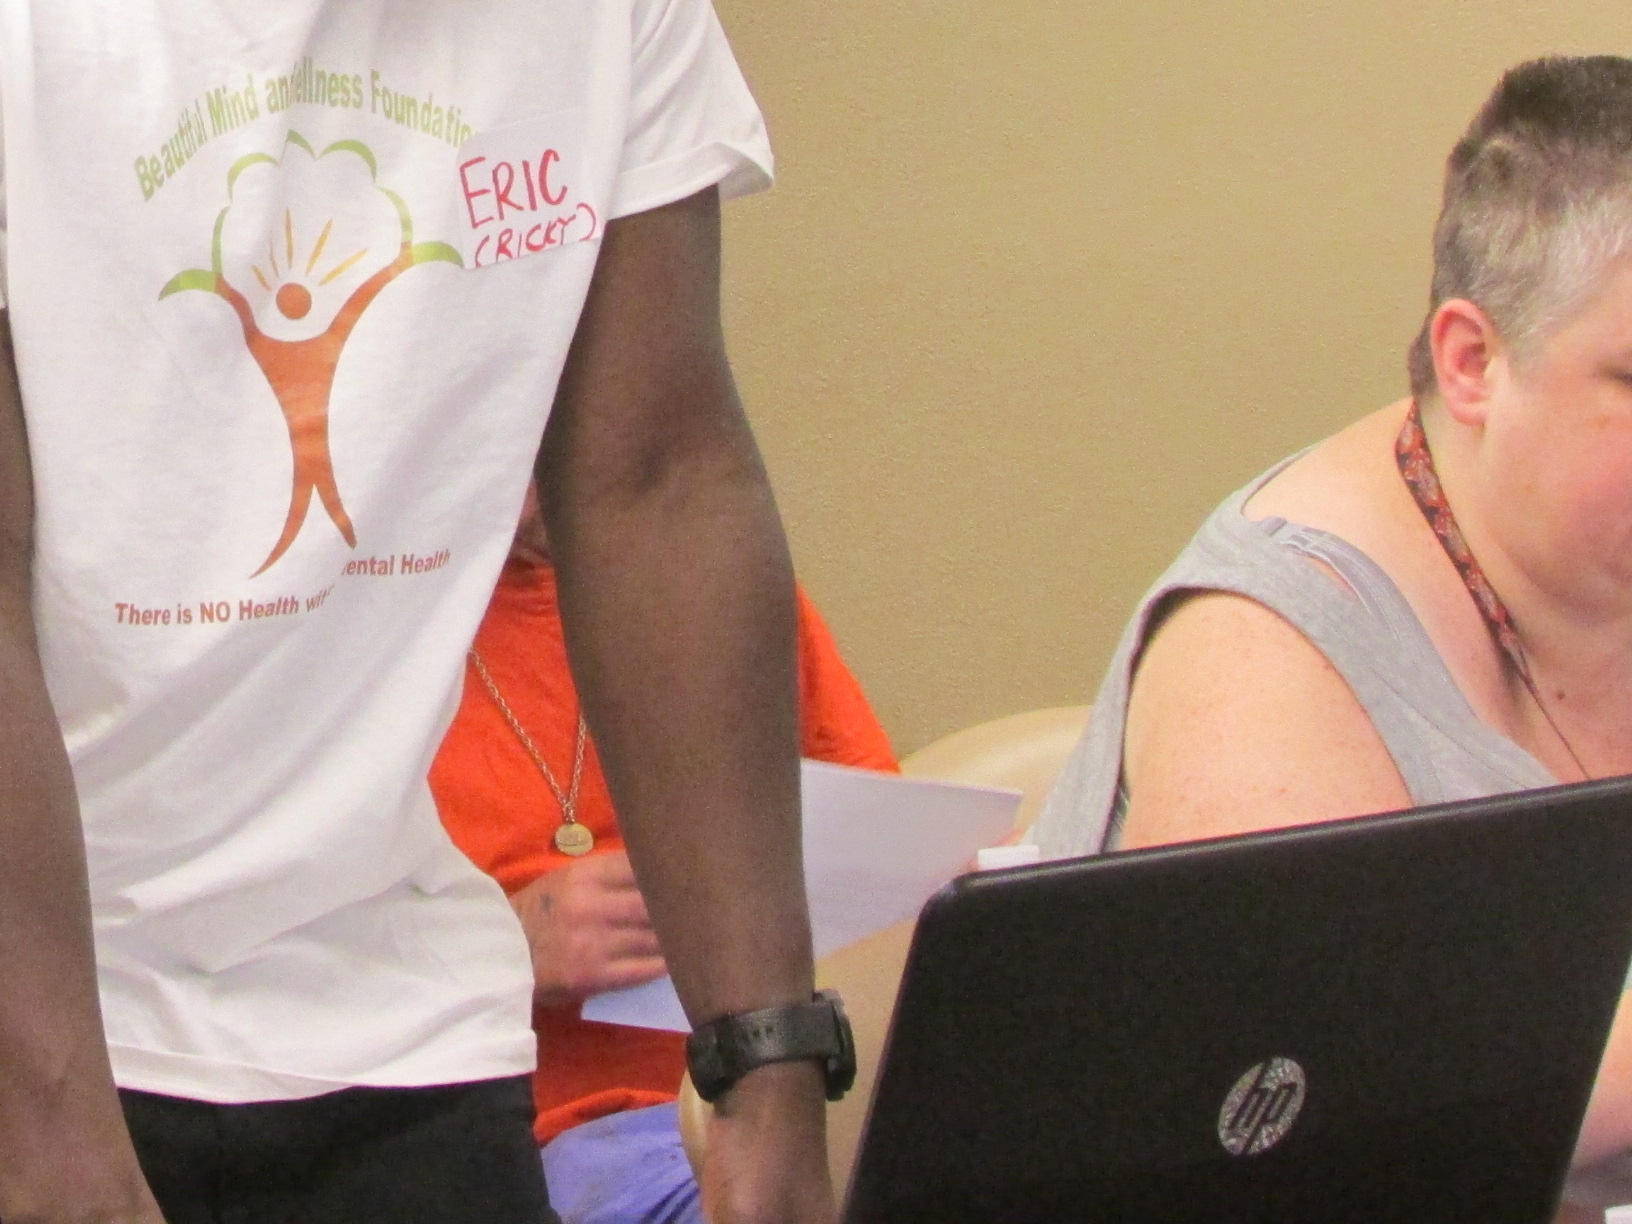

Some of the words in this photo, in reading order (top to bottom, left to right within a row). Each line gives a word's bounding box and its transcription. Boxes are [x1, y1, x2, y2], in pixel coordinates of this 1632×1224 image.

[134, 97, 208, 202] Beautiful
[205, 73, 260, 137] Mind
[369, 69, 474, 148] Foundatio
[459, 149, 568, 229] ERIC
[115, 602, 171, 625] There
[177, 603, 193, 624] is
[200, 601, 231, 623] NO
[239, 595, 300, 621] Health
[342, 554, 395, 576] ental
[401, 548, 451, 575] Health
[1226, 1059, 1299, 1155] hp
